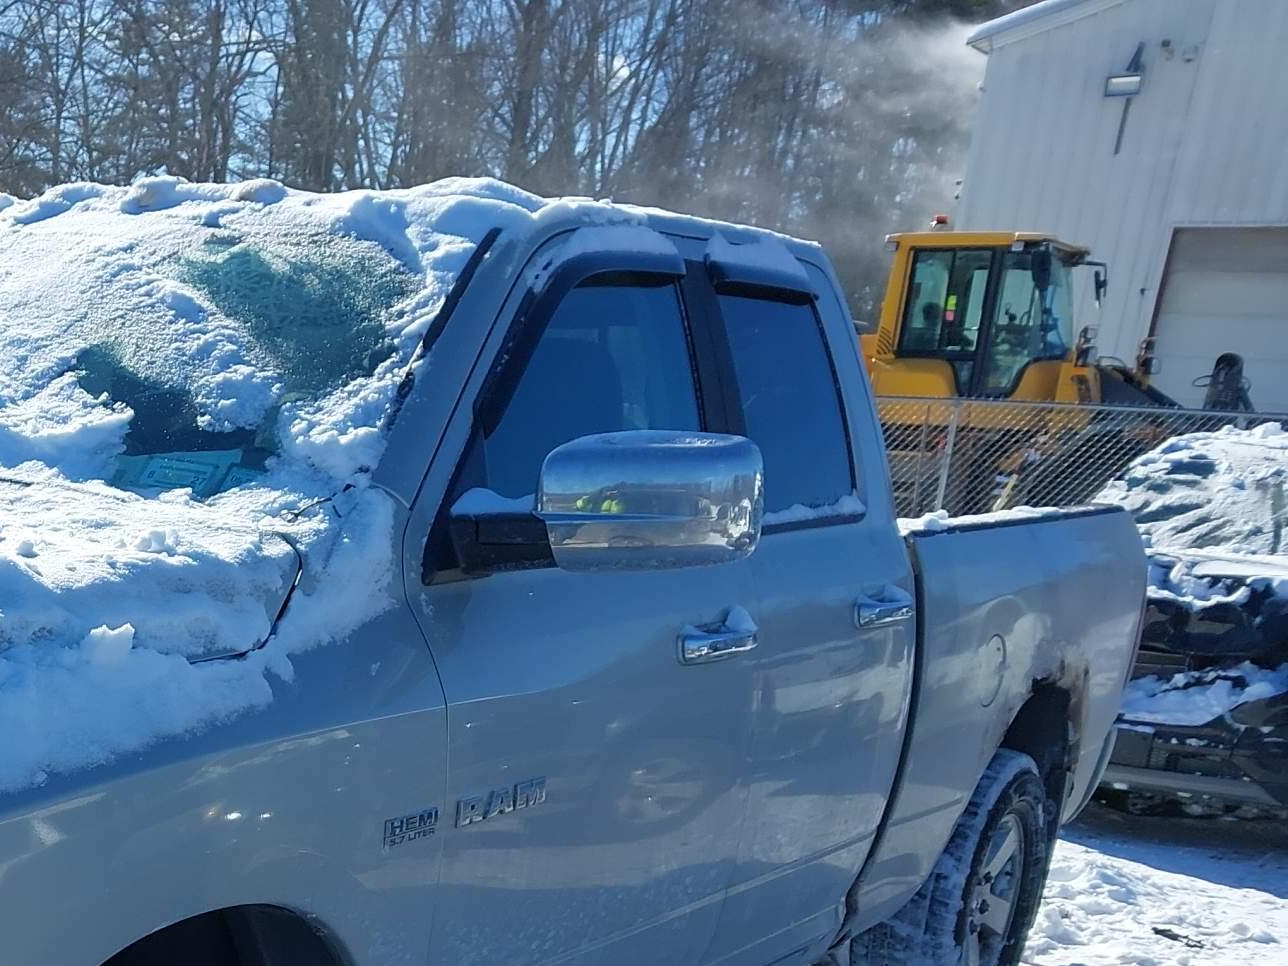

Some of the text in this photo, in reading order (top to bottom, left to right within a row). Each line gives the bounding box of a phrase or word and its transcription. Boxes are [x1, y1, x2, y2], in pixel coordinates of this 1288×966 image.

[455, 776, 547, 829] RAM
[390, 806, 439, 835] HEMI
[389, 827, 436, 848] 5.7 LITER
